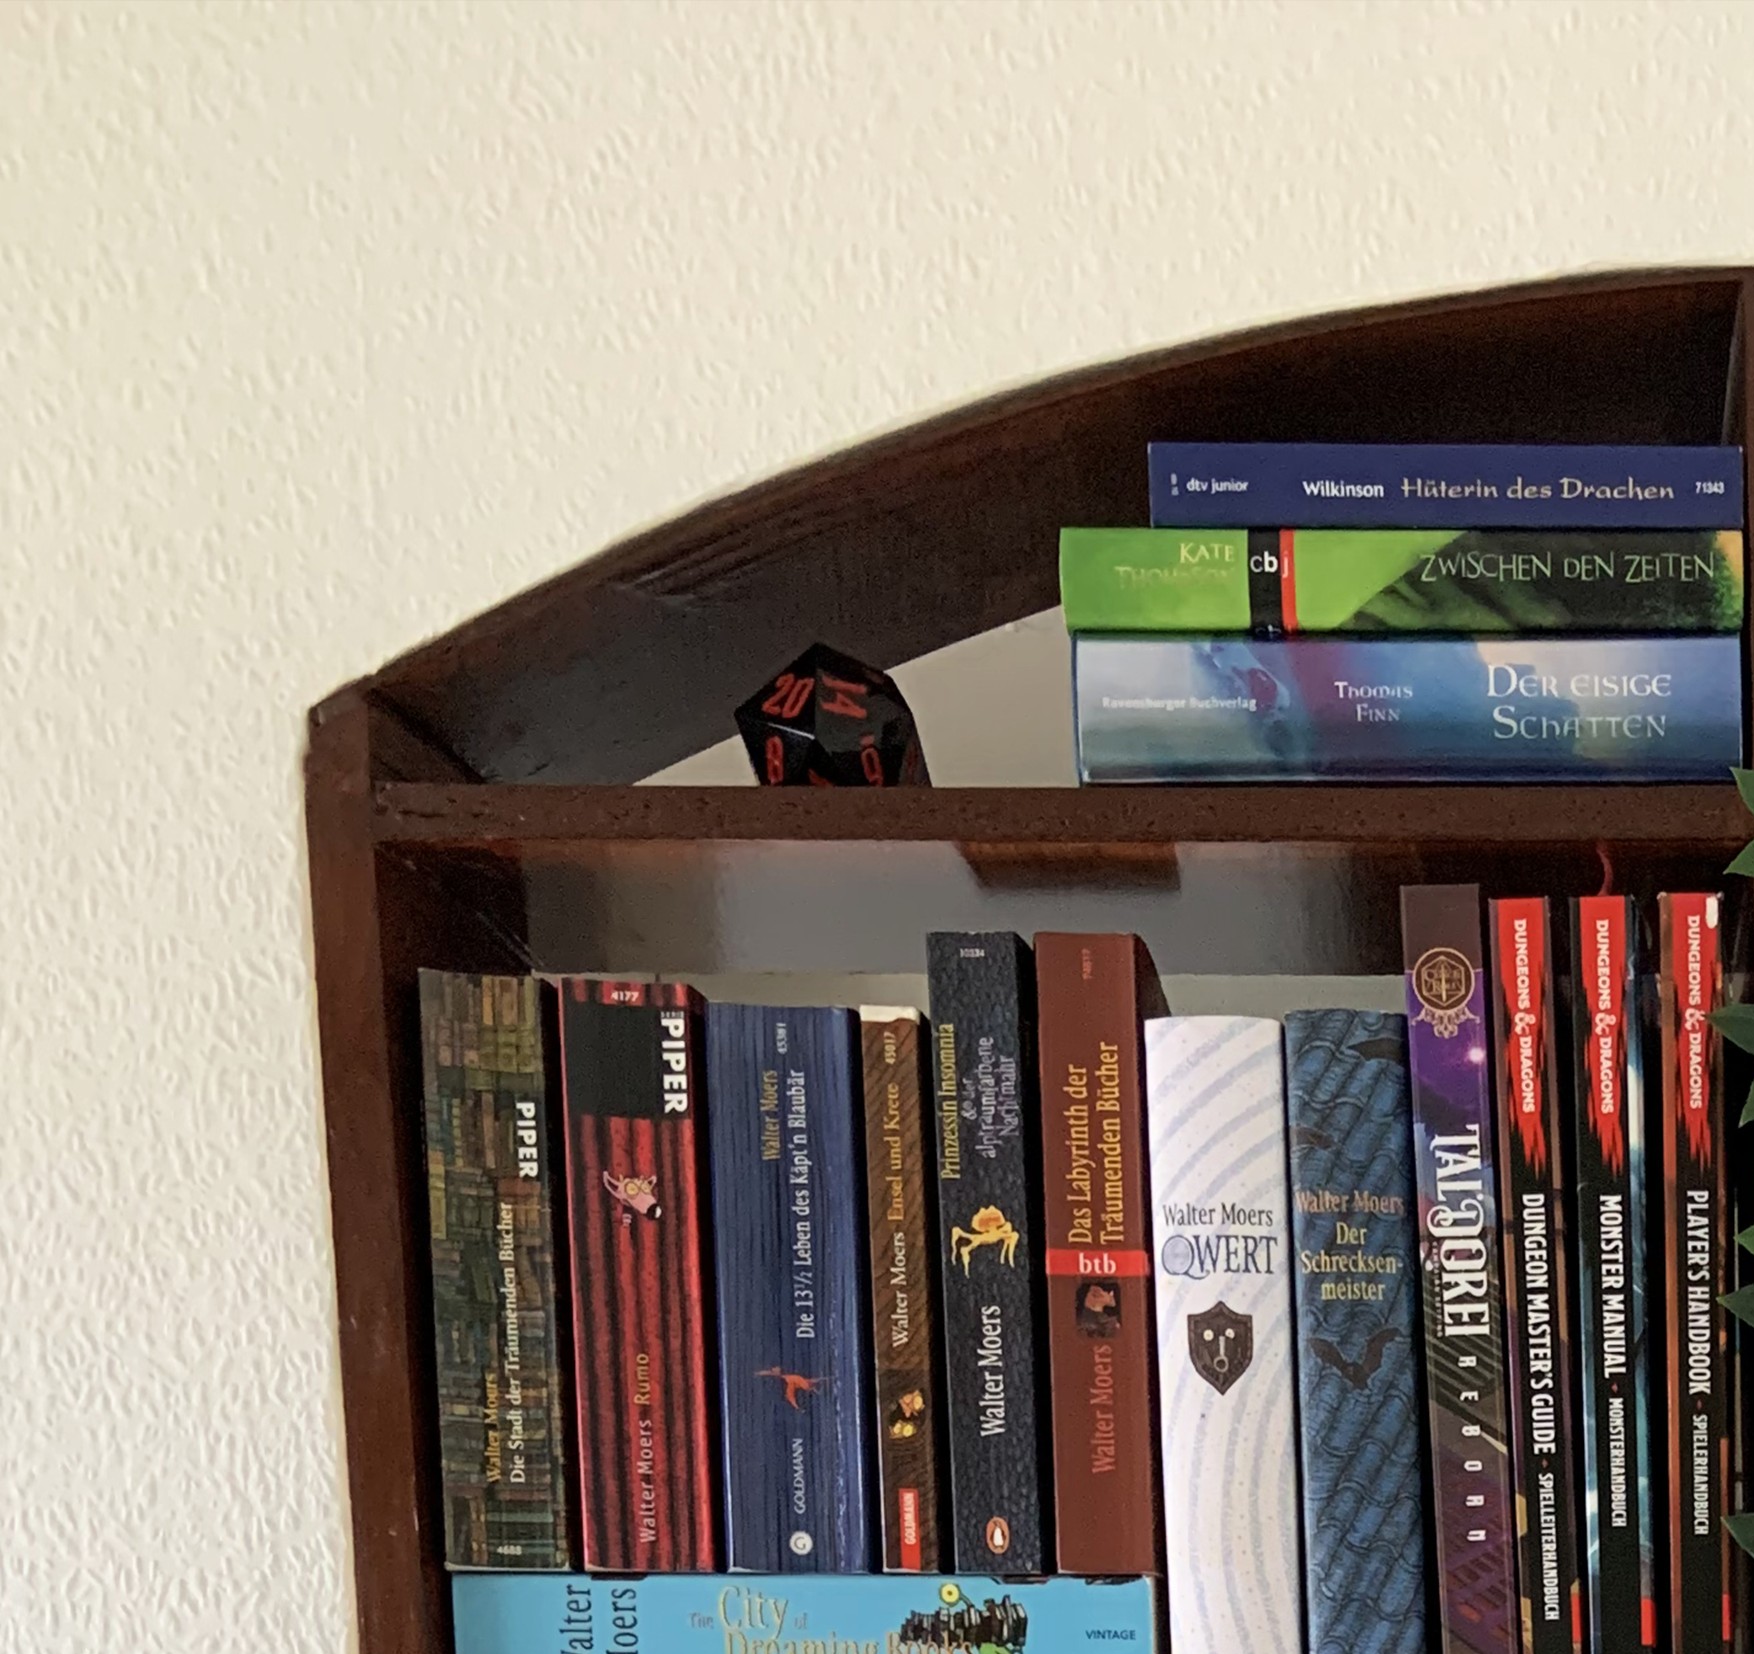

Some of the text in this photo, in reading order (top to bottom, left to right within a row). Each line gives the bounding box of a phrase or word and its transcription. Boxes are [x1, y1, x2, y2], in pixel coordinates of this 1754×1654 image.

[1187, 476, 1248, 494] dtv junior
[1303, 481, 1384, 498] Wilkinson
[1401, 476, 1674, 500] Hüterin des Drachen
[1420, 552, 1715, 582] ZWISCHEN DEN ZEITEN
[1487, 665, 1672, 698] DER EISIGE
[611, 989, 639, 1003] 4177
[660, 1015, 687, 1114] PIPER
[518, 1101, 537, 1179] PIPER
[1063, 1064, 1094, 1243] Das Labyrinth der
[1162, 1234, 1278, 1280] QWERT
[1336, 1223, 1367, 1245] Der
[1599, 1195, 1623, 1289] MONSTER
[1078, 1253, 1116, 1273] btb
[1301, 1250, 1404, 1274] Schrecksen-
[1321, 1279, 1385, 1301] meister
[1521, 1193, 1556, 1455] DUNGEON MASTER'S GUIDE
[1600, 1292, 1626, 1379] MANUAL
[980, 1305, 1004, 1437] Walter Moers
[635, 1352, 657, 1543] Walter Moers Rumo
[1608, 1398, 1626, 1527] MONSTERHANDBUCH
[793, 1438, 806, 1514] GOLDMANN
[1538, 1473, 1559, 1621] SPIELLEITERHANDBUCH
[1086, 1629, 1136, 1641] VINTAGE
